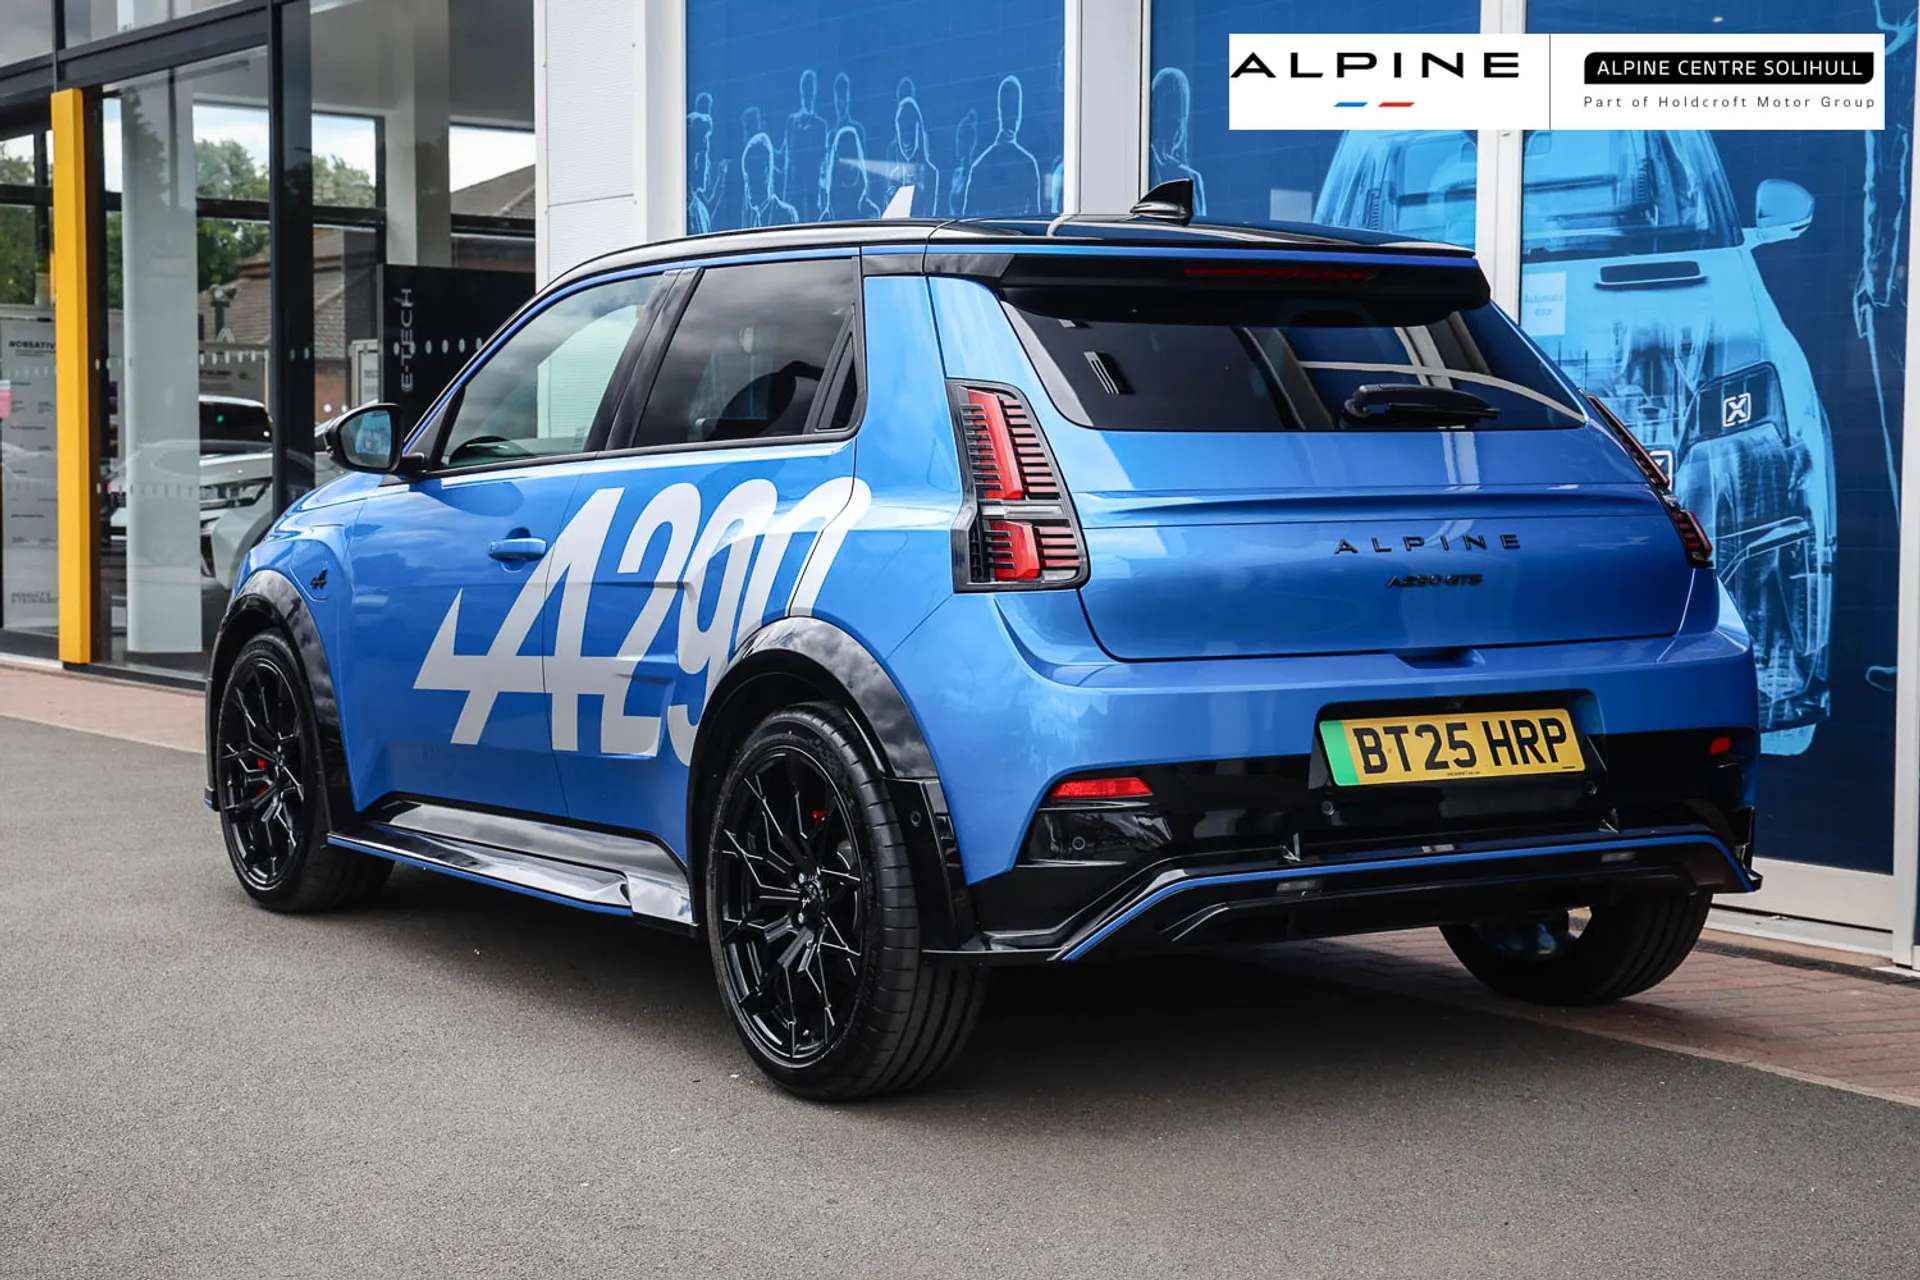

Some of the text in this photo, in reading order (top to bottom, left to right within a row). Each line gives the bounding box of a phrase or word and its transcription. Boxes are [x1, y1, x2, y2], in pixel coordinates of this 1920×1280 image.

[1334, 534, 1521, 554] ALPINE
[1352, 717, 1567, 775] BT25 HRP
